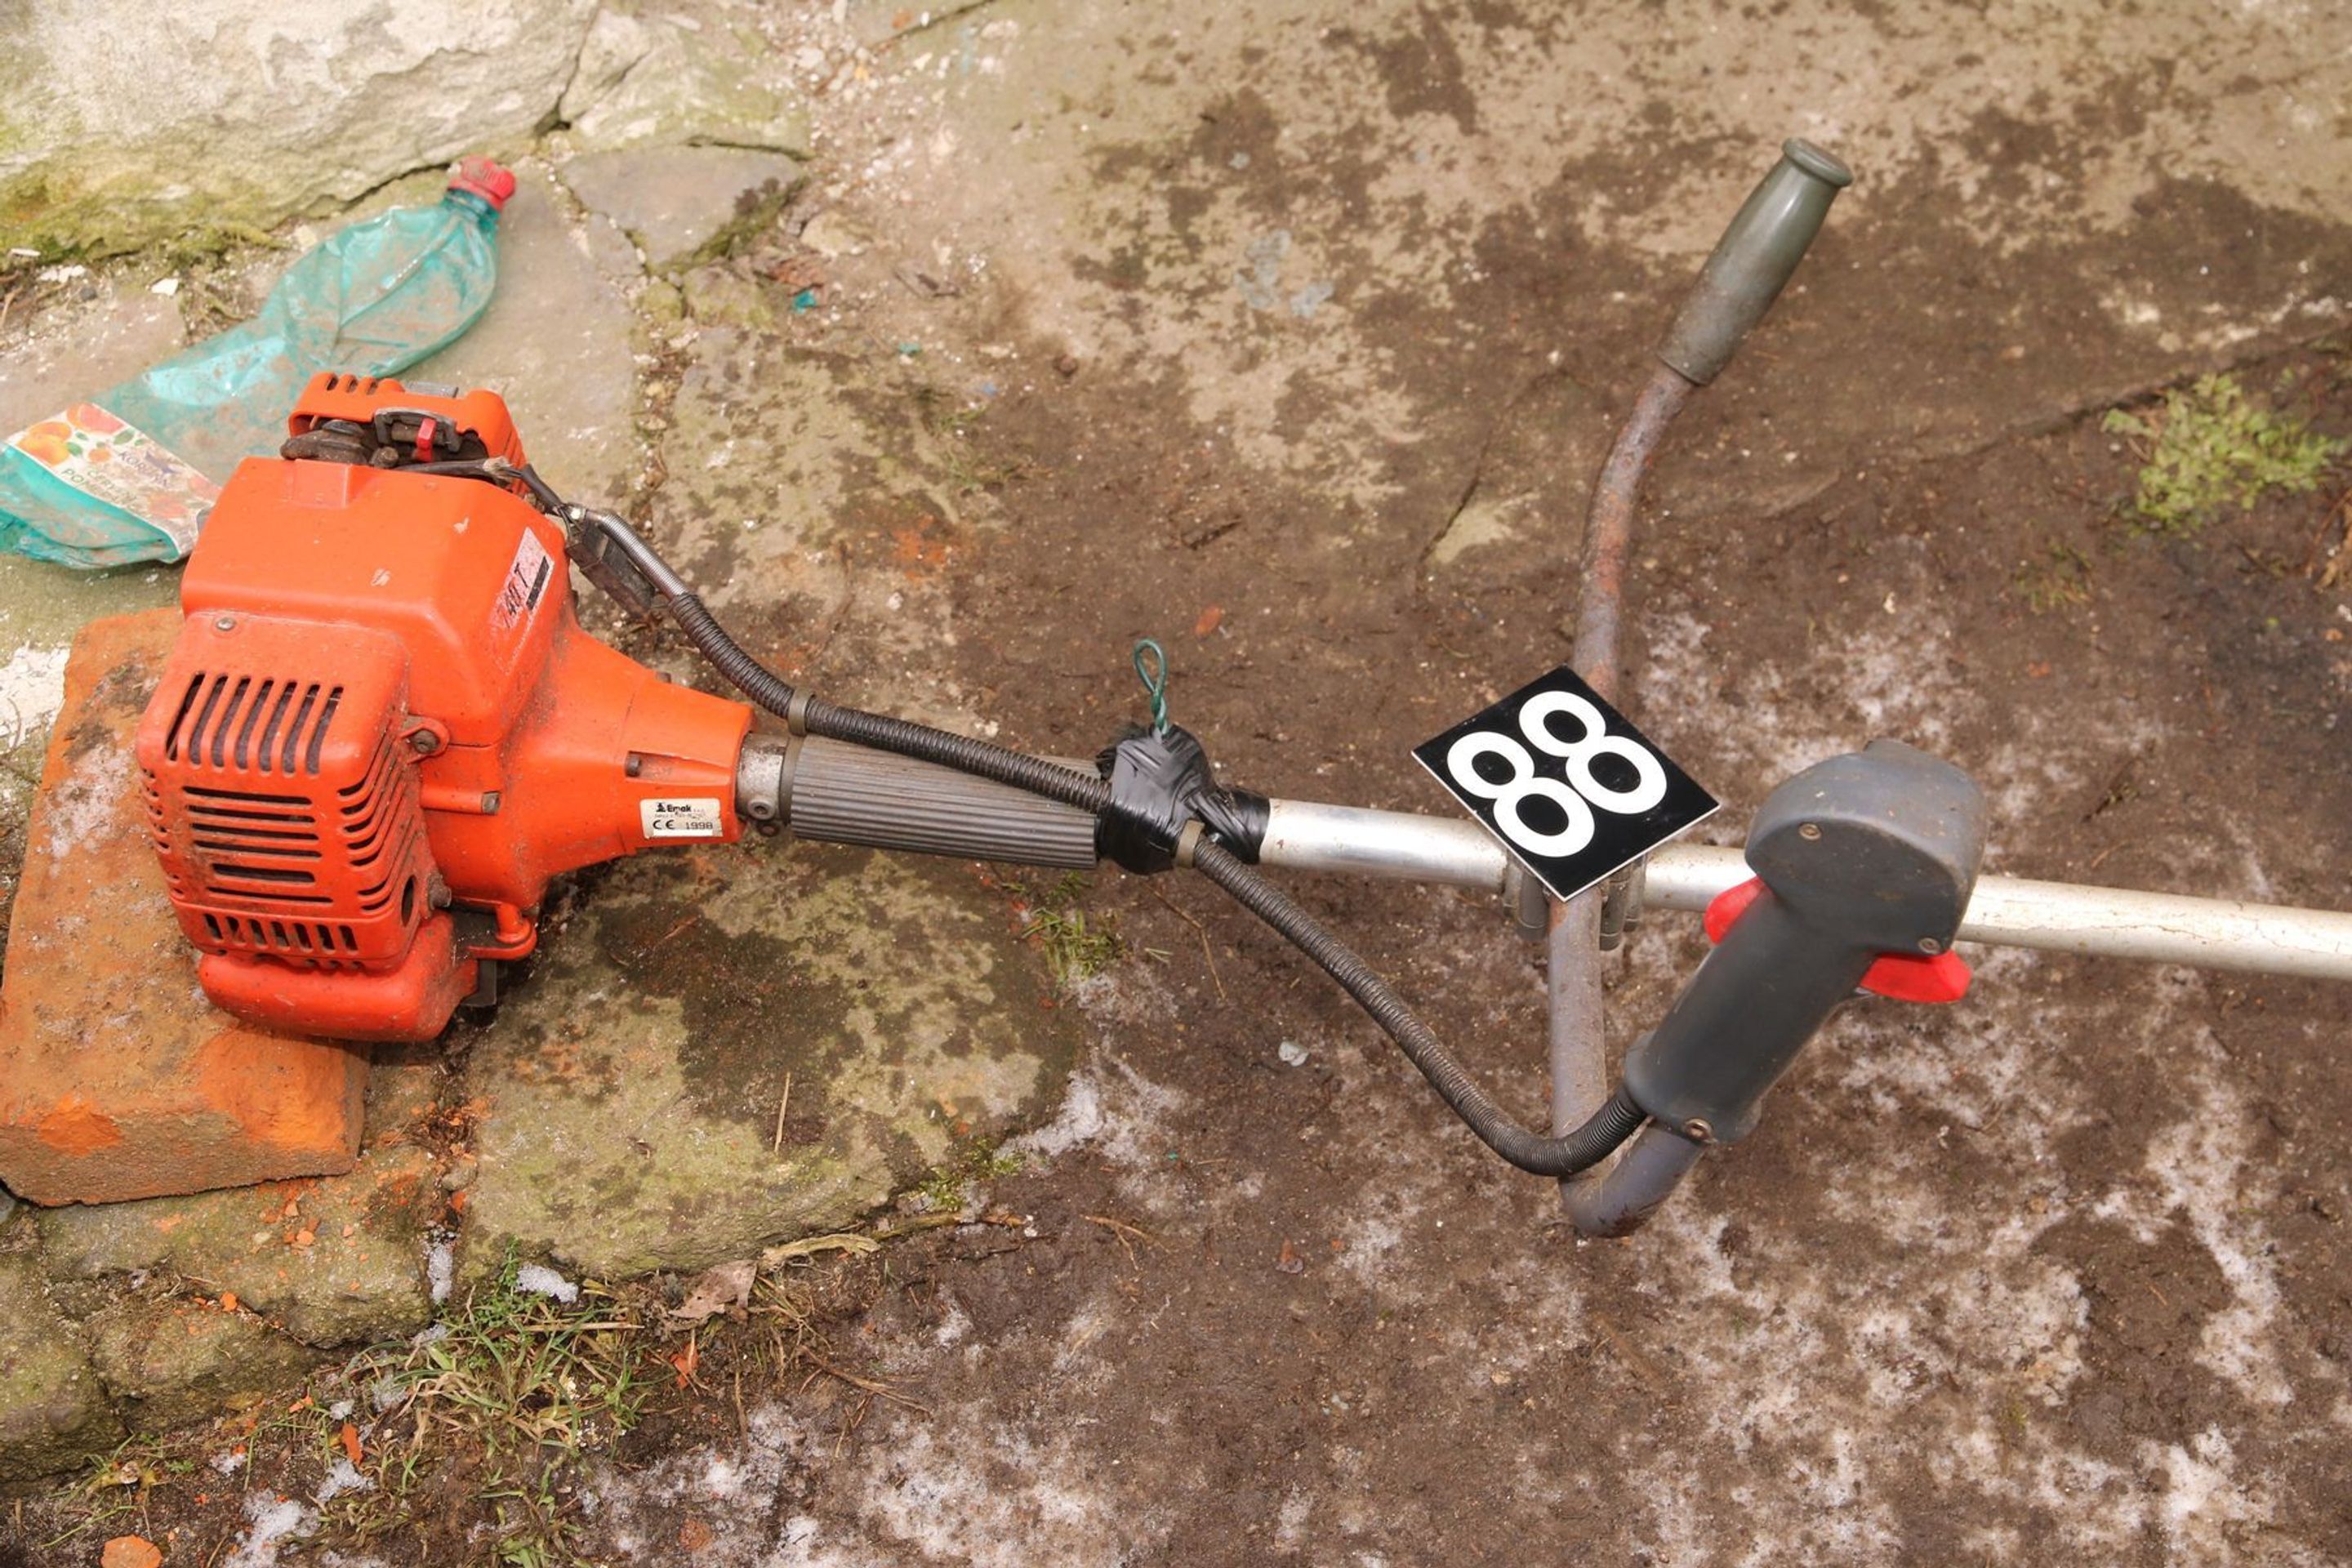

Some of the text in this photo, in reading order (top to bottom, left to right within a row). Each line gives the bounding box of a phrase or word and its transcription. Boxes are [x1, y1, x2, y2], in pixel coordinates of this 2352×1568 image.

[1447, 690, 1667, 858] 88
[666, 804, 692, 813] Emak
[685, 821, 713, 830] 1998
